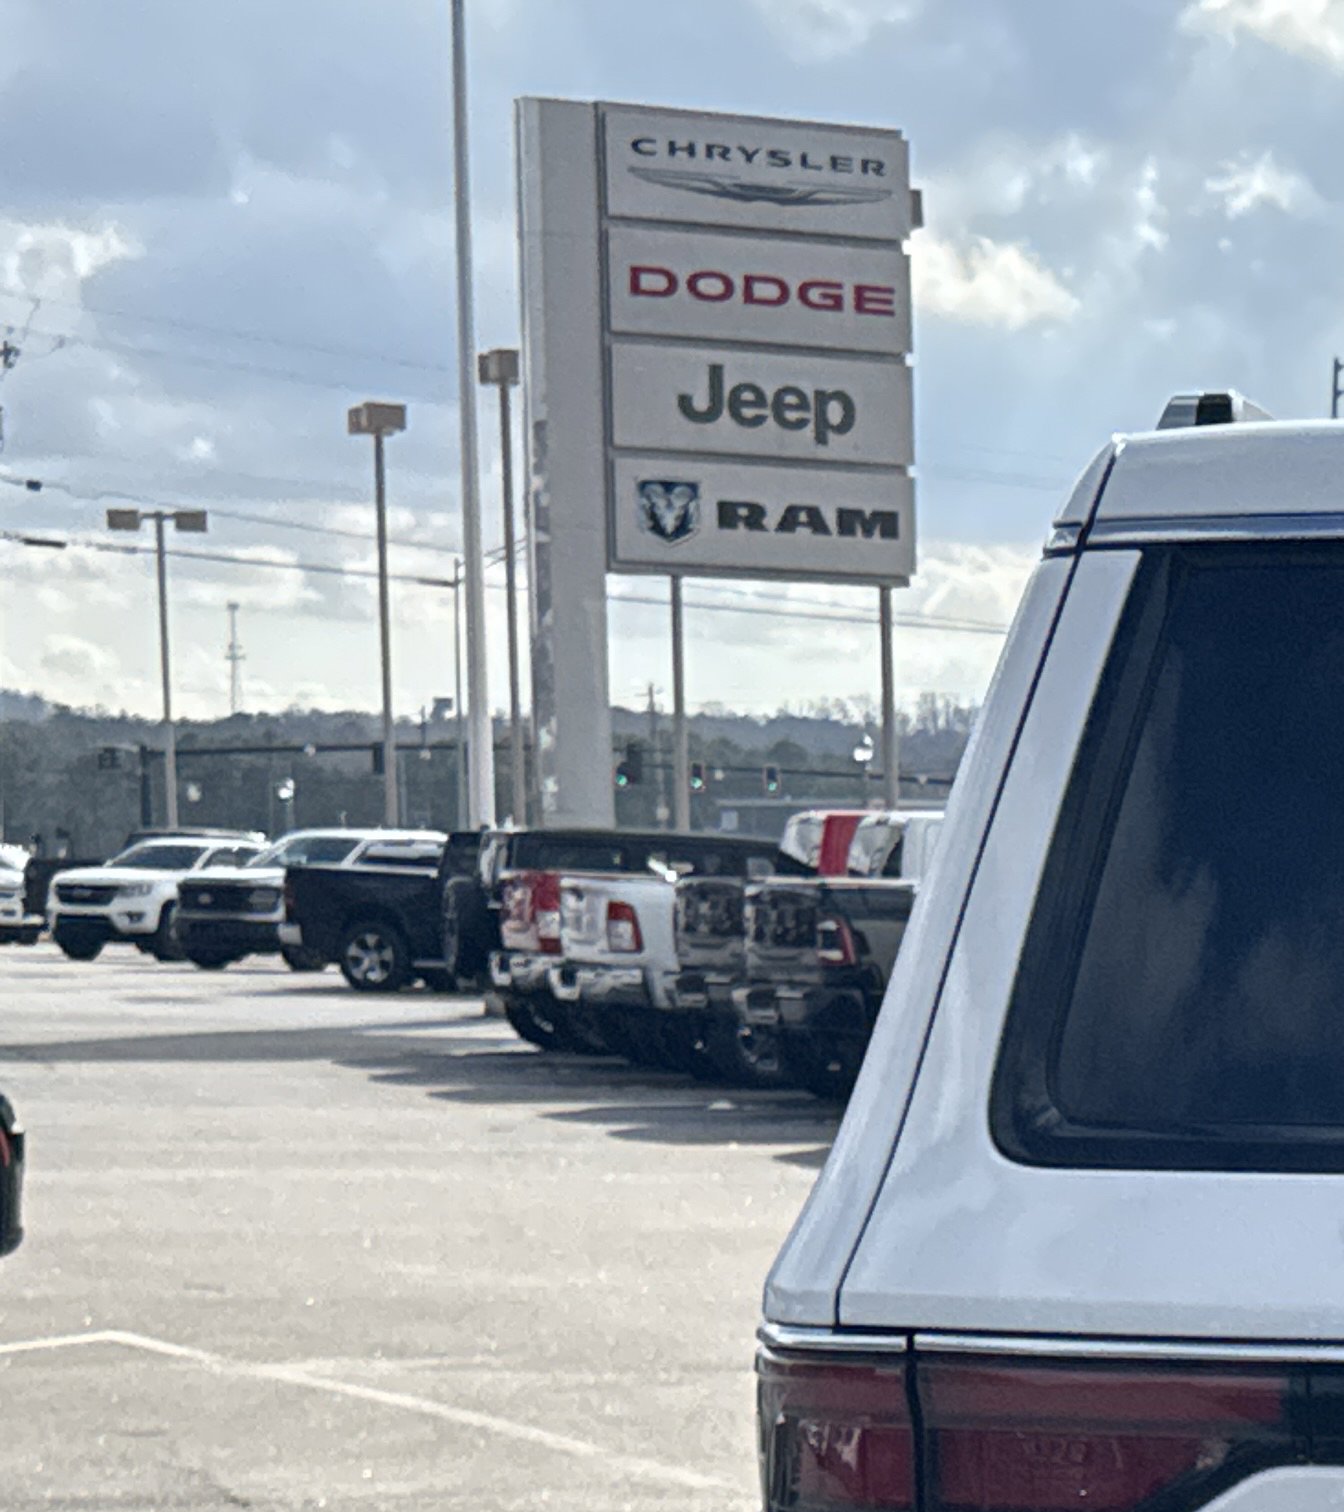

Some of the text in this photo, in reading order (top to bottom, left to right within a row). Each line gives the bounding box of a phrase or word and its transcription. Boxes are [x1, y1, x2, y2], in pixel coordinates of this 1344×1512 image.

[630, 137, 886, 177] CHRYSLER
[629, 265, 896, 317] DODGE
[677, 363, 857, 445] Jeep
[717, 500, 899, 540] RAM
